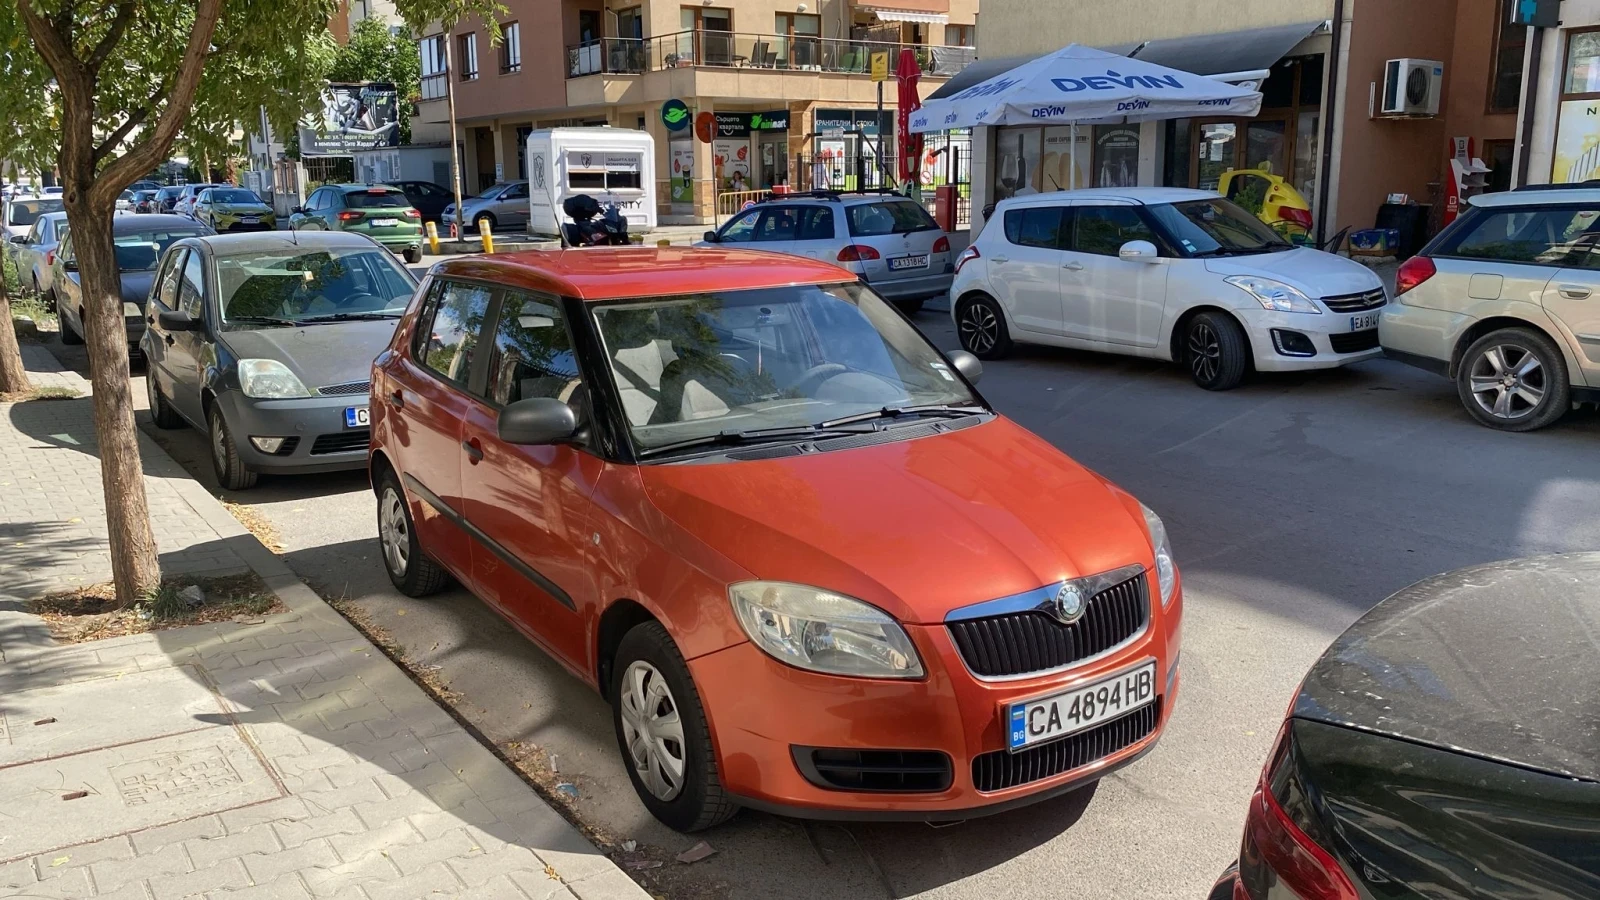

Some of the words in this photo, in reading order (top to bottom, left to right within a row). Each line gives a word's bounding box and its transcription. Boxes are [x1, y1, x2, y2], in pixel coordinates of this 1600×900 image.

[1051, 70, 1184, 92] DEVIN
[1031, 105, 1065, 118] DEVIN
[1117, 100, 1150, 111] DEVIN
[1013, 731, 1024, 741] BG
[1029, 702, 1062, 736] CA
